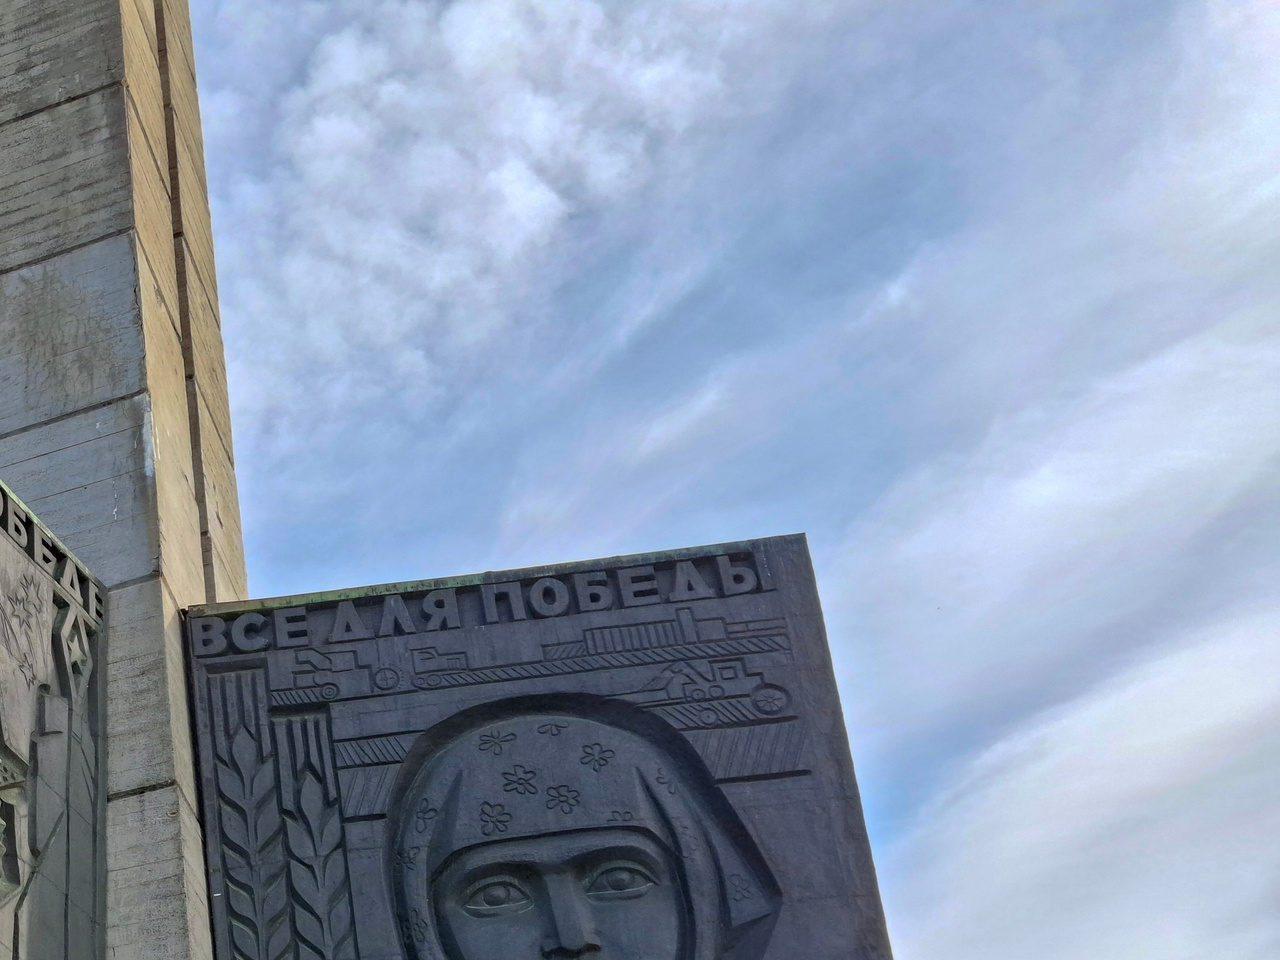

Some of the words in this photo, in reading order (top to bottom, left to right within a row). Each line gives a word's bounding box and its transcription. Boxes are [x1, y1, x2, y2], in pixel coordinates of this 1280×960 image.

[191, 606, 309, 656] ВСЕ
[329, 588, 461, 643] ДЛЯ
[483, 553, 773, 625] ПОБЕДЫ
